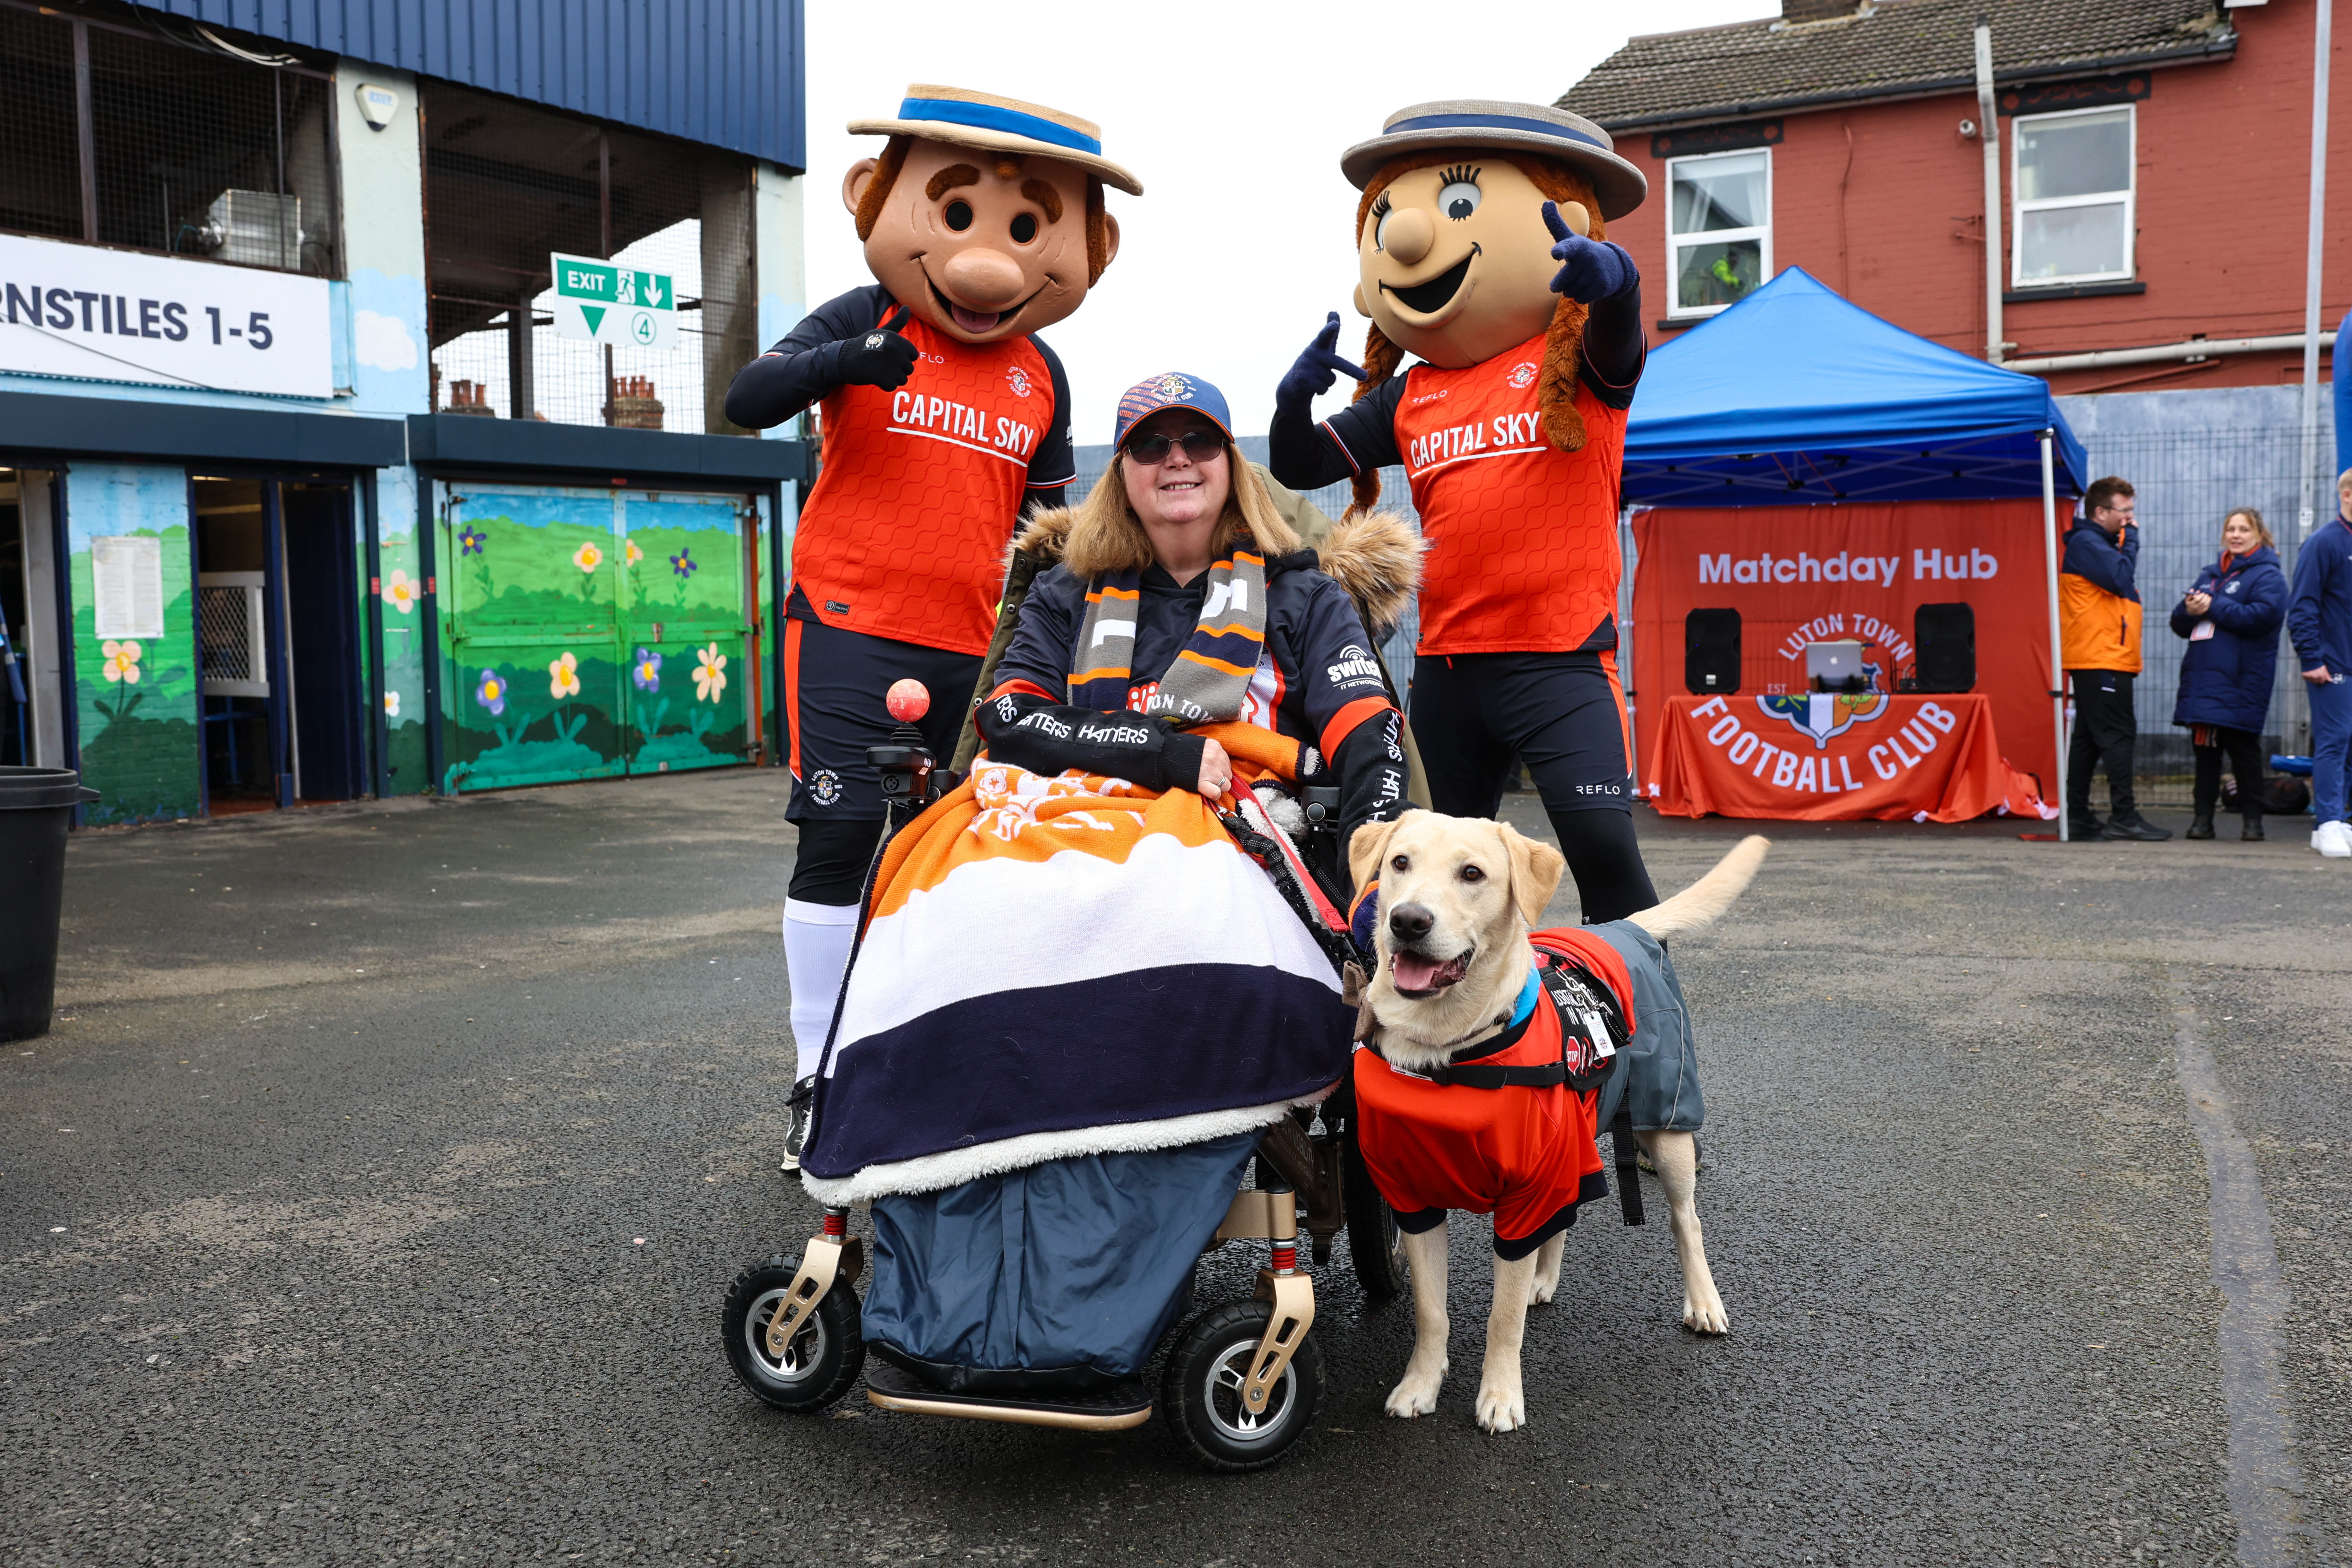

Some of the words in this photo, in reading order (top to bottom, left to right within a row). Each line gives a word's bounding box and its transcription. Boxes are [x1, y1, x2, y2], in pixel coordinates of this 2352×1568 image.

[567, 270, 606, 292] EXIT
[0, 283, 189, 341] NSTILES
[205, 307, 273, 350] 1-5
[639, 318, 649, 338] 4
[919, 351, 945, 364] FLO
[1156, 393, 1181, 402] FOOTBALL
[1412, 390, 1448, 404] REFLO
[893, 391, 988, 442] CAPITAL
[994, 417, 1034, 456] SKY
[1411, 422, 1487, 469] CAPITAL
[1493, 410, 1541, 446] SKY
[1700, 551, 1900, 587] Matchday
[1914, 548, 1998, 580] Hub
[1778, 613, 1844, 661] LUTON
[1852, 613, 1913, 662] TOWN
[1347, 679, 1382, 688] NETWORKING
[1767, 683, 1787, 694] EST
[1078, 725, 1149, 744] HATTERS
[1690, 695, 1863, 794] FOOTBALL
[1867, 701, 1956, 781] CLUB
[811, 769, 824, 782] LUTON
[825, 769, 839, 781] TOWN
[1576, 785, 1620, 795] REFLO
[811, 793, 831, 805] FOOTBALL
[830, 792, 841, 803] CLUB
[1567, 1050, 1578, 1063] STOP
